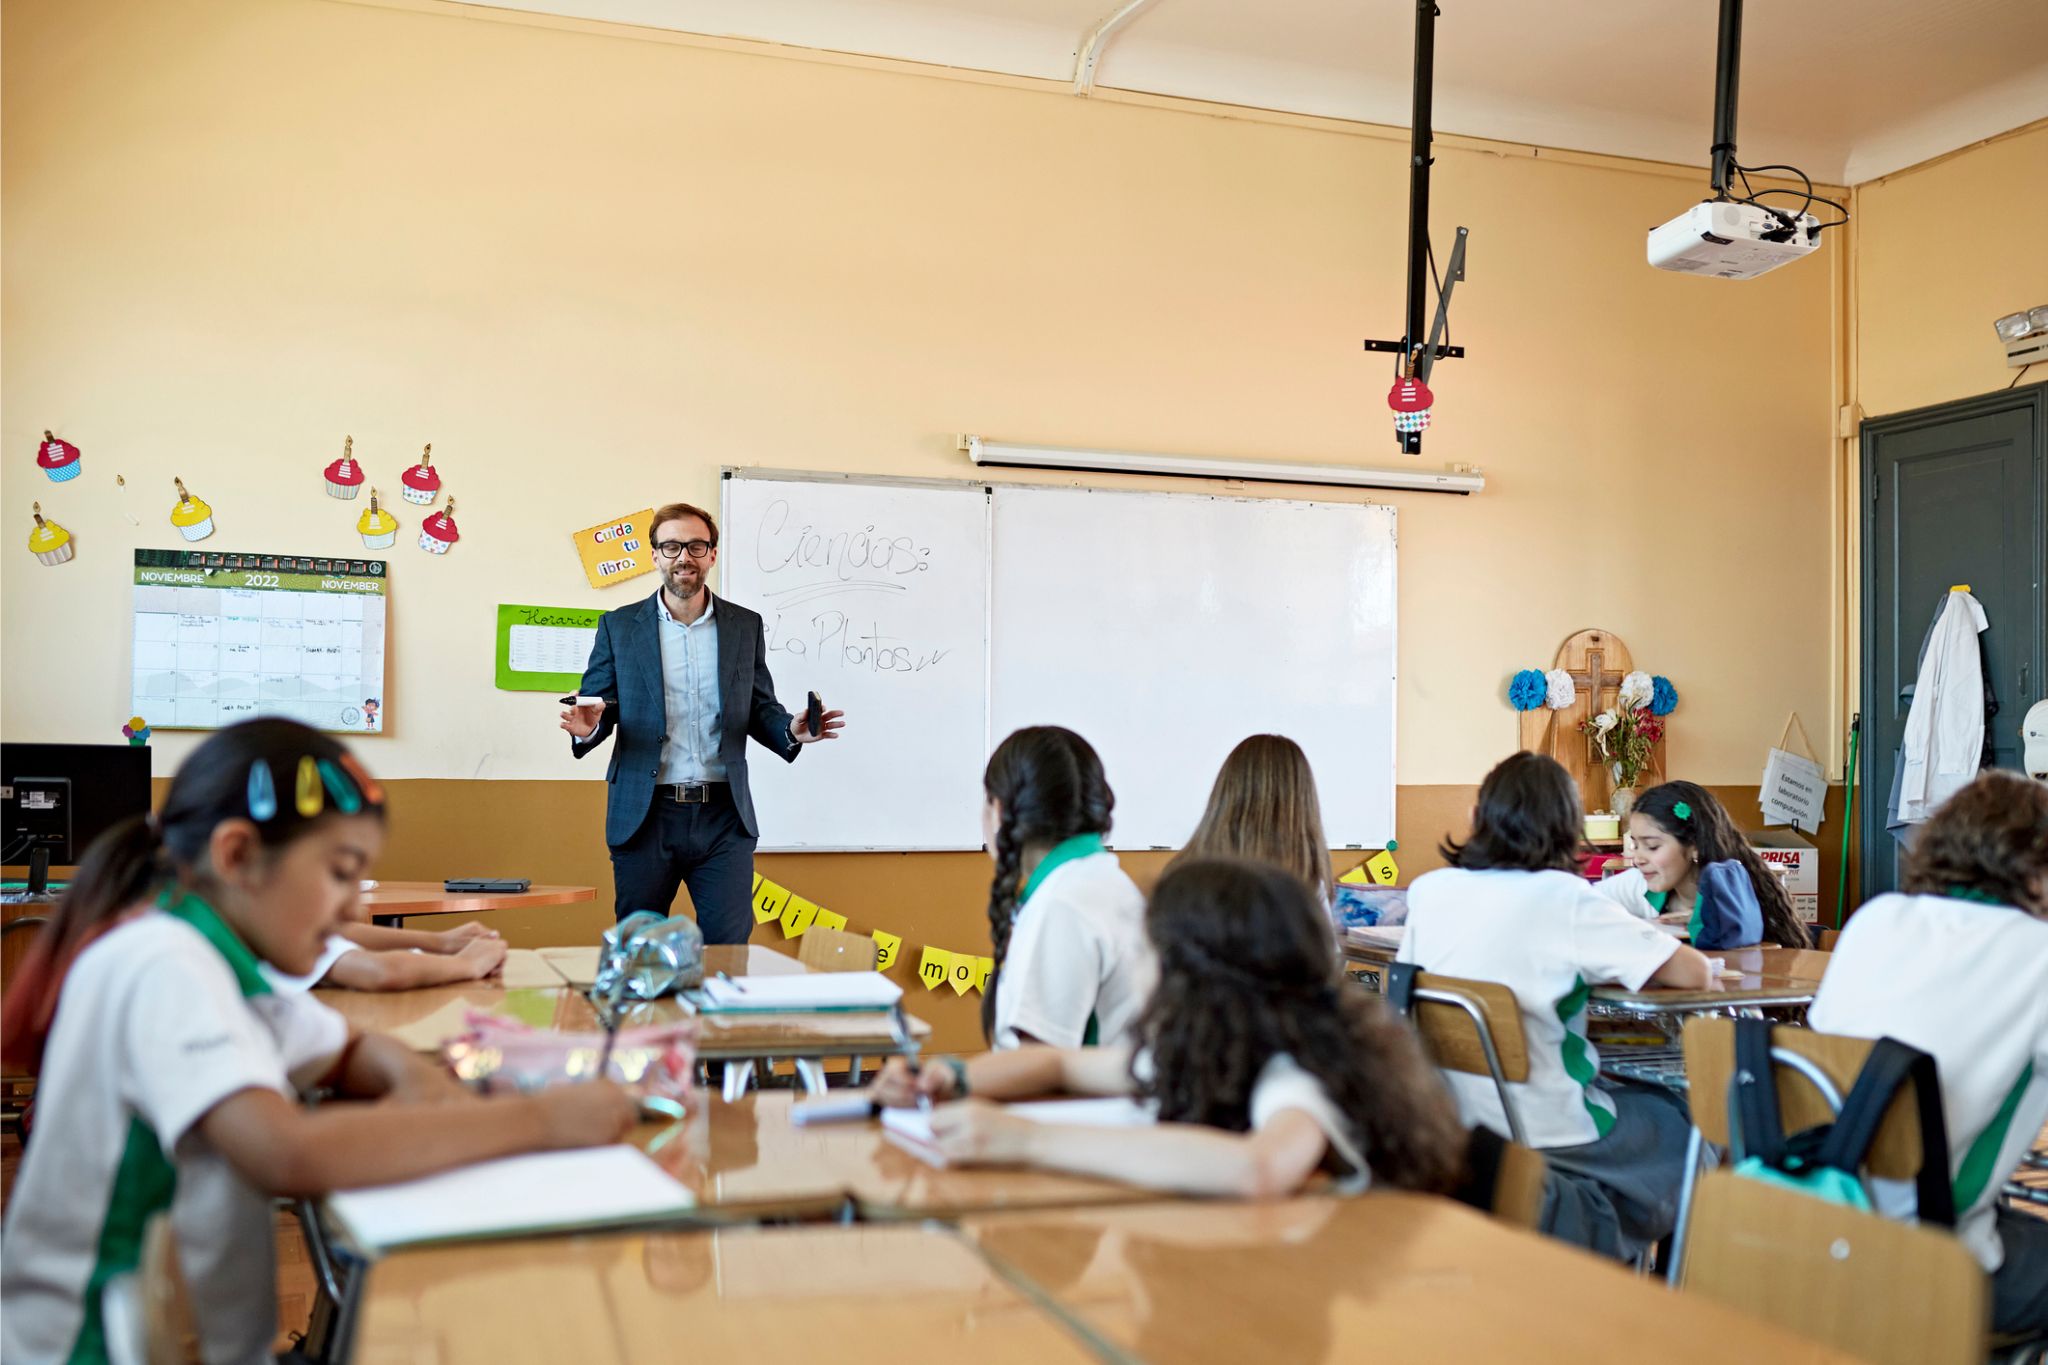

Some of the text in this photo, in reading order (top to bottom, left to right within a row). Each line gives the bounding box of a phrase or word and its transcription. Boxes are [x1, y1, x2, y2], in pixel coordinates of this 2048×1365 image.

[594, 523, 632, 543] Cuida
[757, 499, 930, 581] Ciencias:
[624, 540, 639, 552] tu
[598, 559, 635, 576] libro.
[141, 572, 379, 591] NOVIEMBRE 2022 NOVEMBER
[520, 608, 596, 627] Horario
[1781, 773, 1805, 790] Estamos
[1778, 785, 1809, 806] laboratorio
[1760, 852, 1800, 864] PRISA
